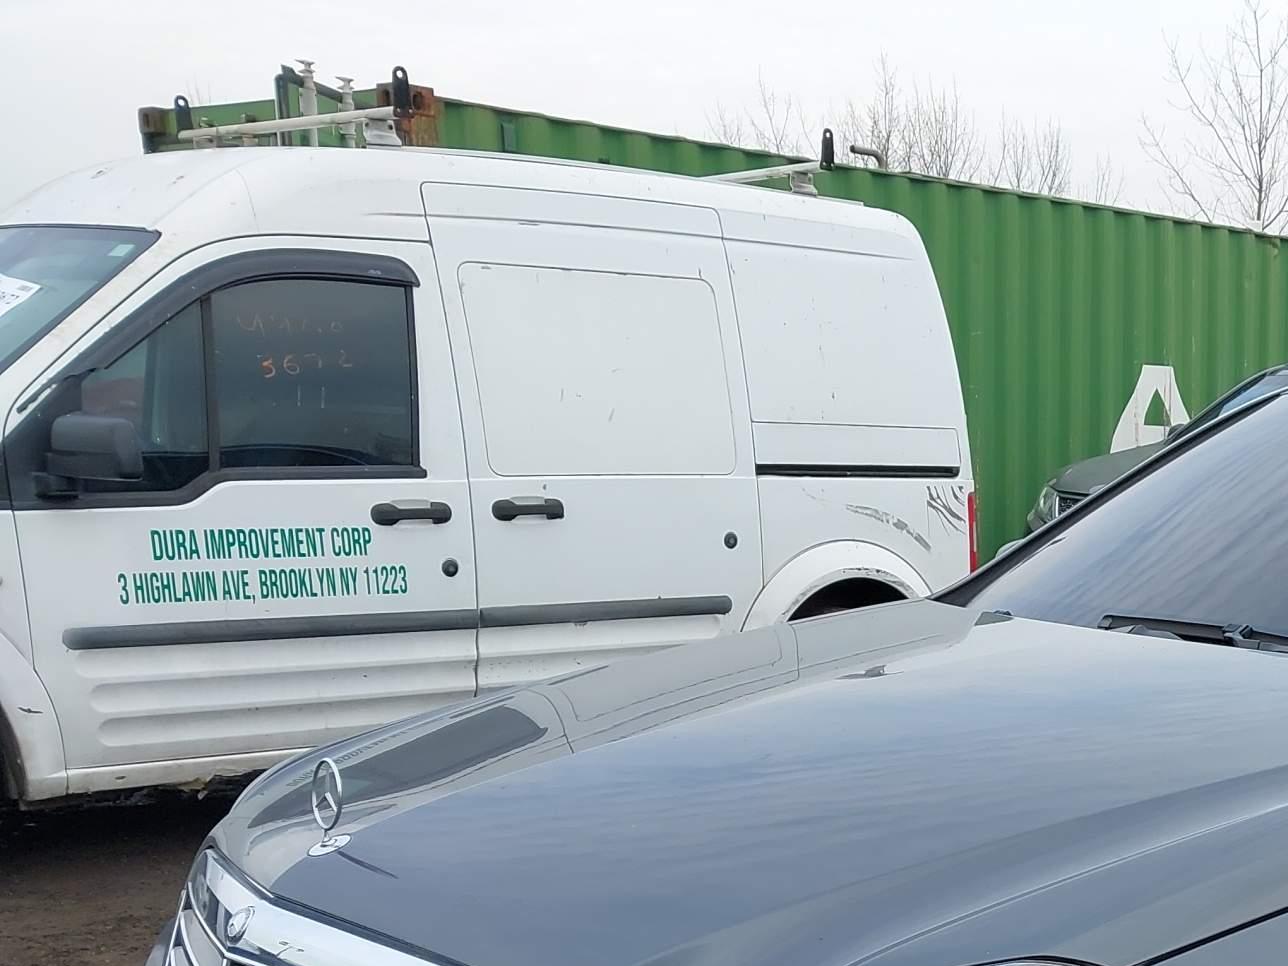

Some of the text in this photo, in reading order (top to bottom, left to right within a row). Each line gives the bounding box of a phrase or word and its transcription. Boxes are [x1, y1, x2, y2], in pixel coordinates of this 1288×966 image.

[1110, 364, 1191, 454] A
[149, 526, 373, 561] DURA IMPROVEMENT CORP
[117, 565, 409, 604] 3 HIGHLAWN AVE, BROOKLYN NY 11223
